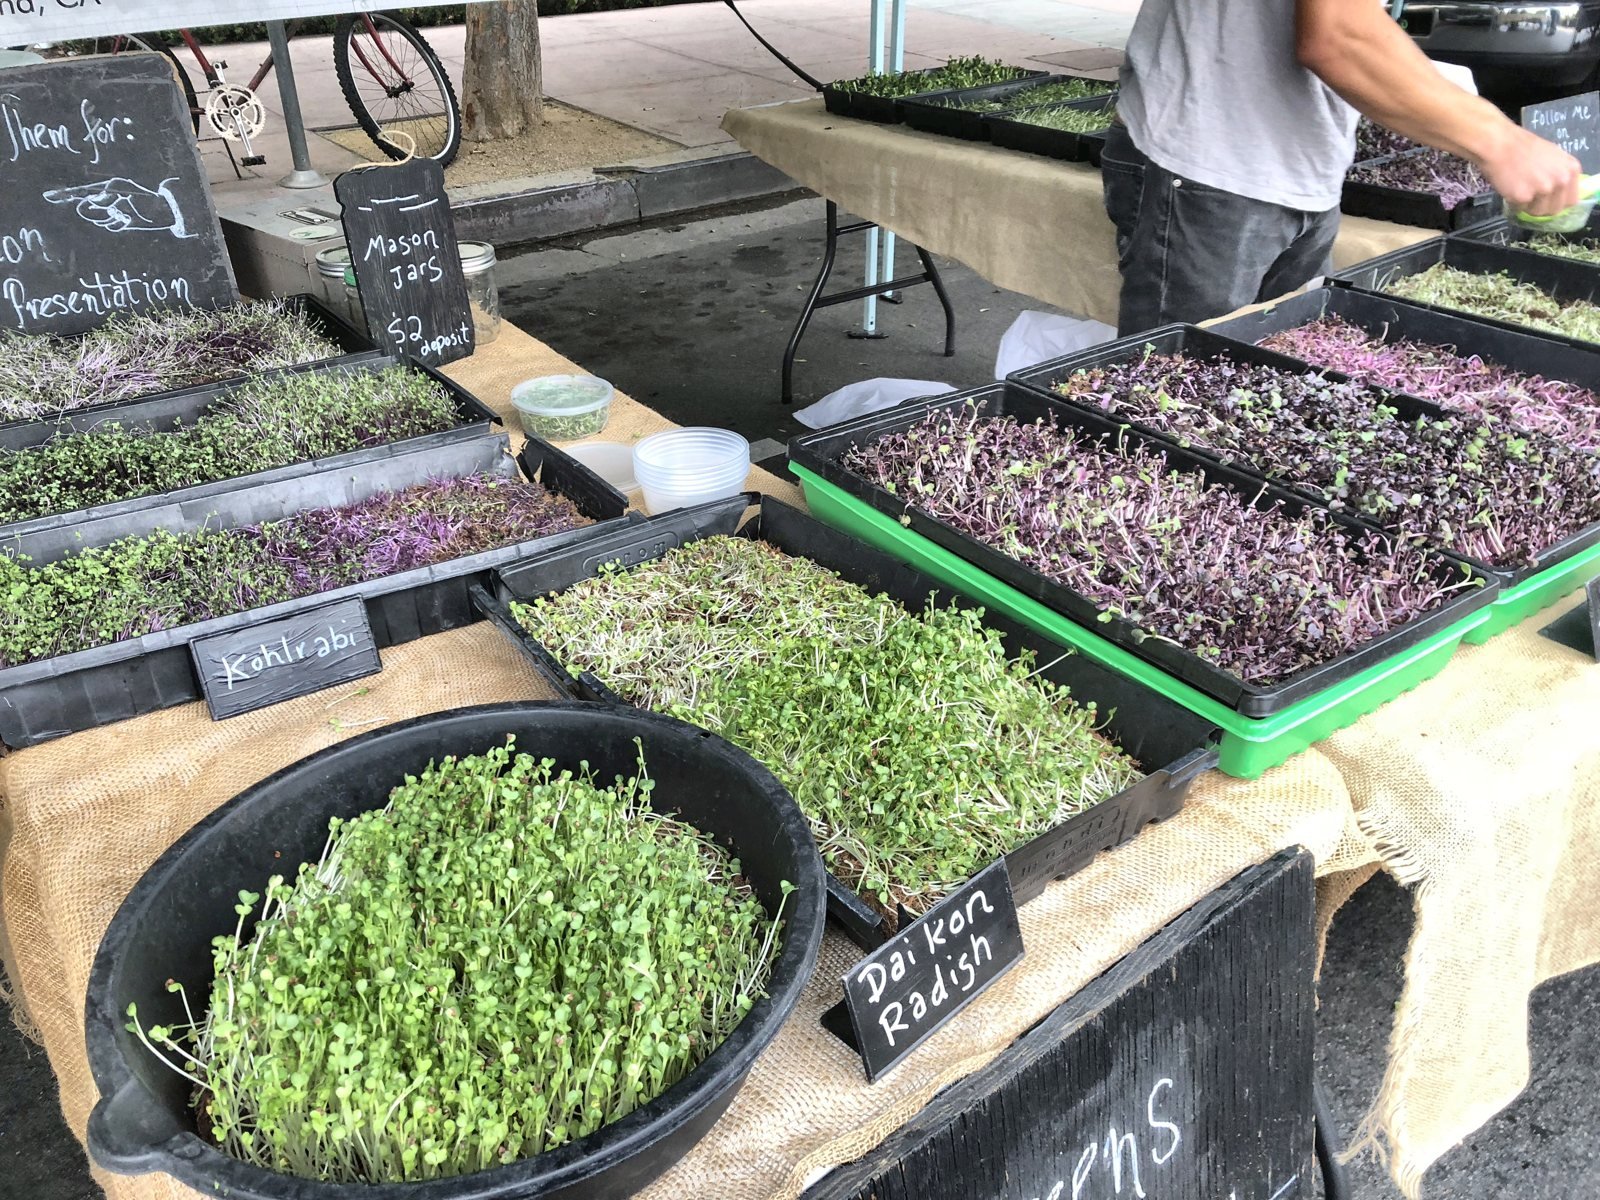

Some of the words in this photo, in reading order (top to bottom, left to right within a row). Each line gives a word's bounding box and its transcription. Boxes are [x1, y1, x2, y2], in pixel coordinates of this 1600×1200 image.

[0, 93, 81, 162] Them
[81, 98, 135, 164] for:
[1531, 109, 1567, 130] follow
[1556, 127, 1570, 139] on
[0, 227, 53, 263] on
[364, 229, 440, 262] Mason
[389, 256, 443, 290] Jars
[3, 269, 192, 329] Presentation
[387, 311, 422, 354] $2
[420, 318, 470, 356] deposit
[221, 619, 357, 690] Kohlrabi
[878, 933, 993, 1047] Radish
